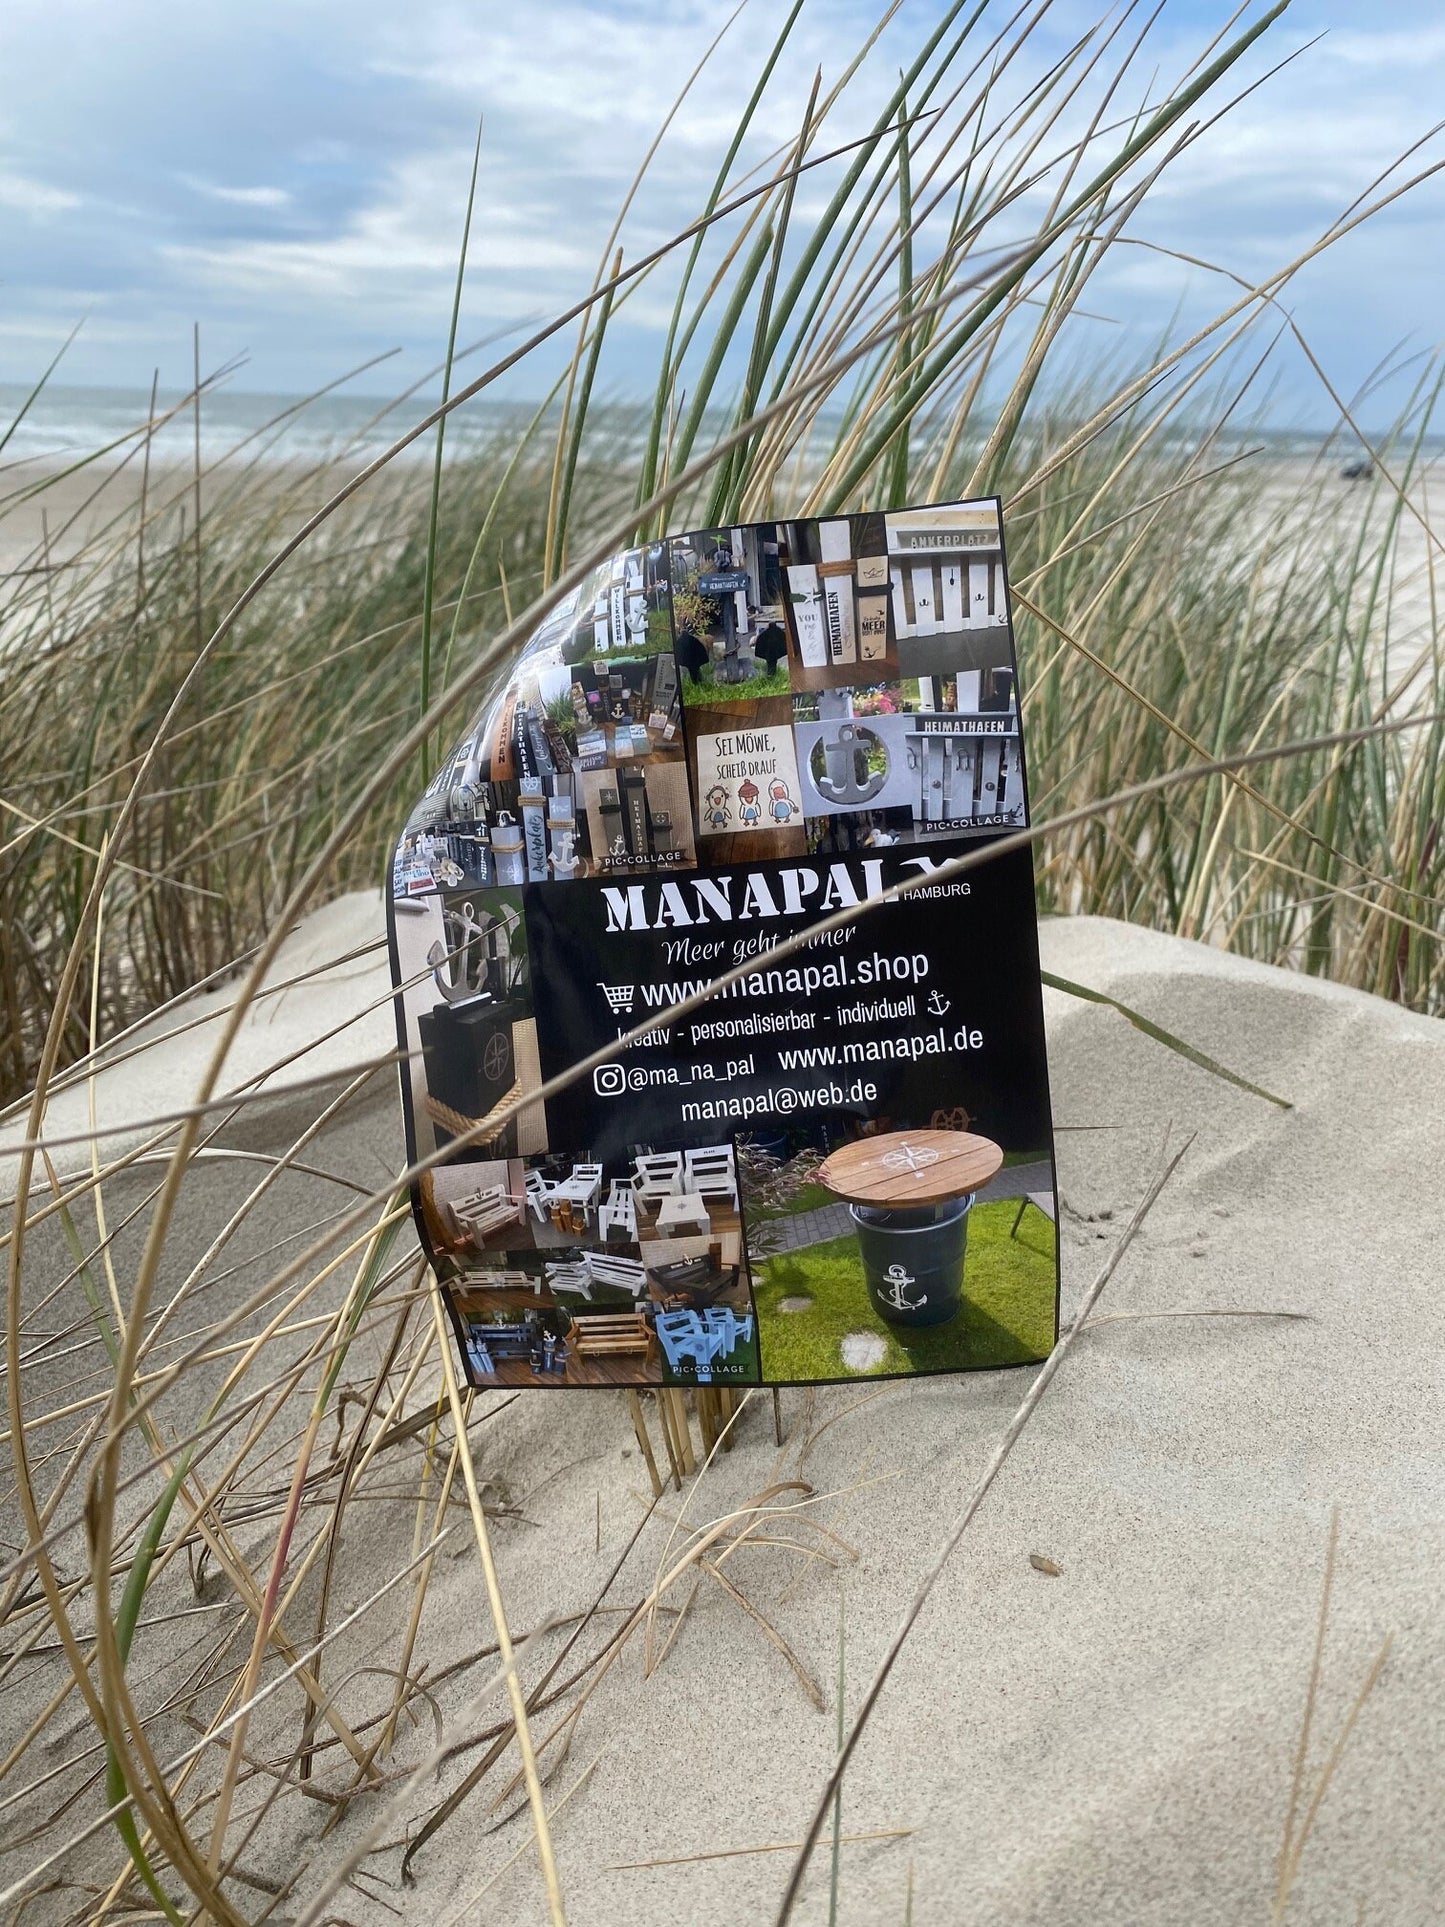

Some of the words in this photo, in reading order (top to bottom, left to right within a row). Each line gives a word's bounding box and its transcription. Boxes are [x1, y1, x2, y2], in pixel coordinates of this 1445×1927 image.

[827, 592, 842, 656] HEIMATHAFEN
[736, 733, 776, 754] MÖWE,
[924, 721, 1005, 732] HEIMATHAFEN
[748, 759, 777, 776] DRAUF
[600, 859, 899, 932] MANAPAL
[904, 883, 971, 901] HAMBURG
[661, 938, 725, 966] Meer
[733, 929, 781, 965] geht
[640, 952, 929, 1006] www.manapal.shop
[691, 1011, 816, 1045] personalisierbar
[837, 995, 916, 1026] individuell
[628, 1054, 754, 1090] @ma_na_pal
[778, 1025, 984, 1070] www.manapal.de
[681, 1079, 877, 1121] manapal@web.de
